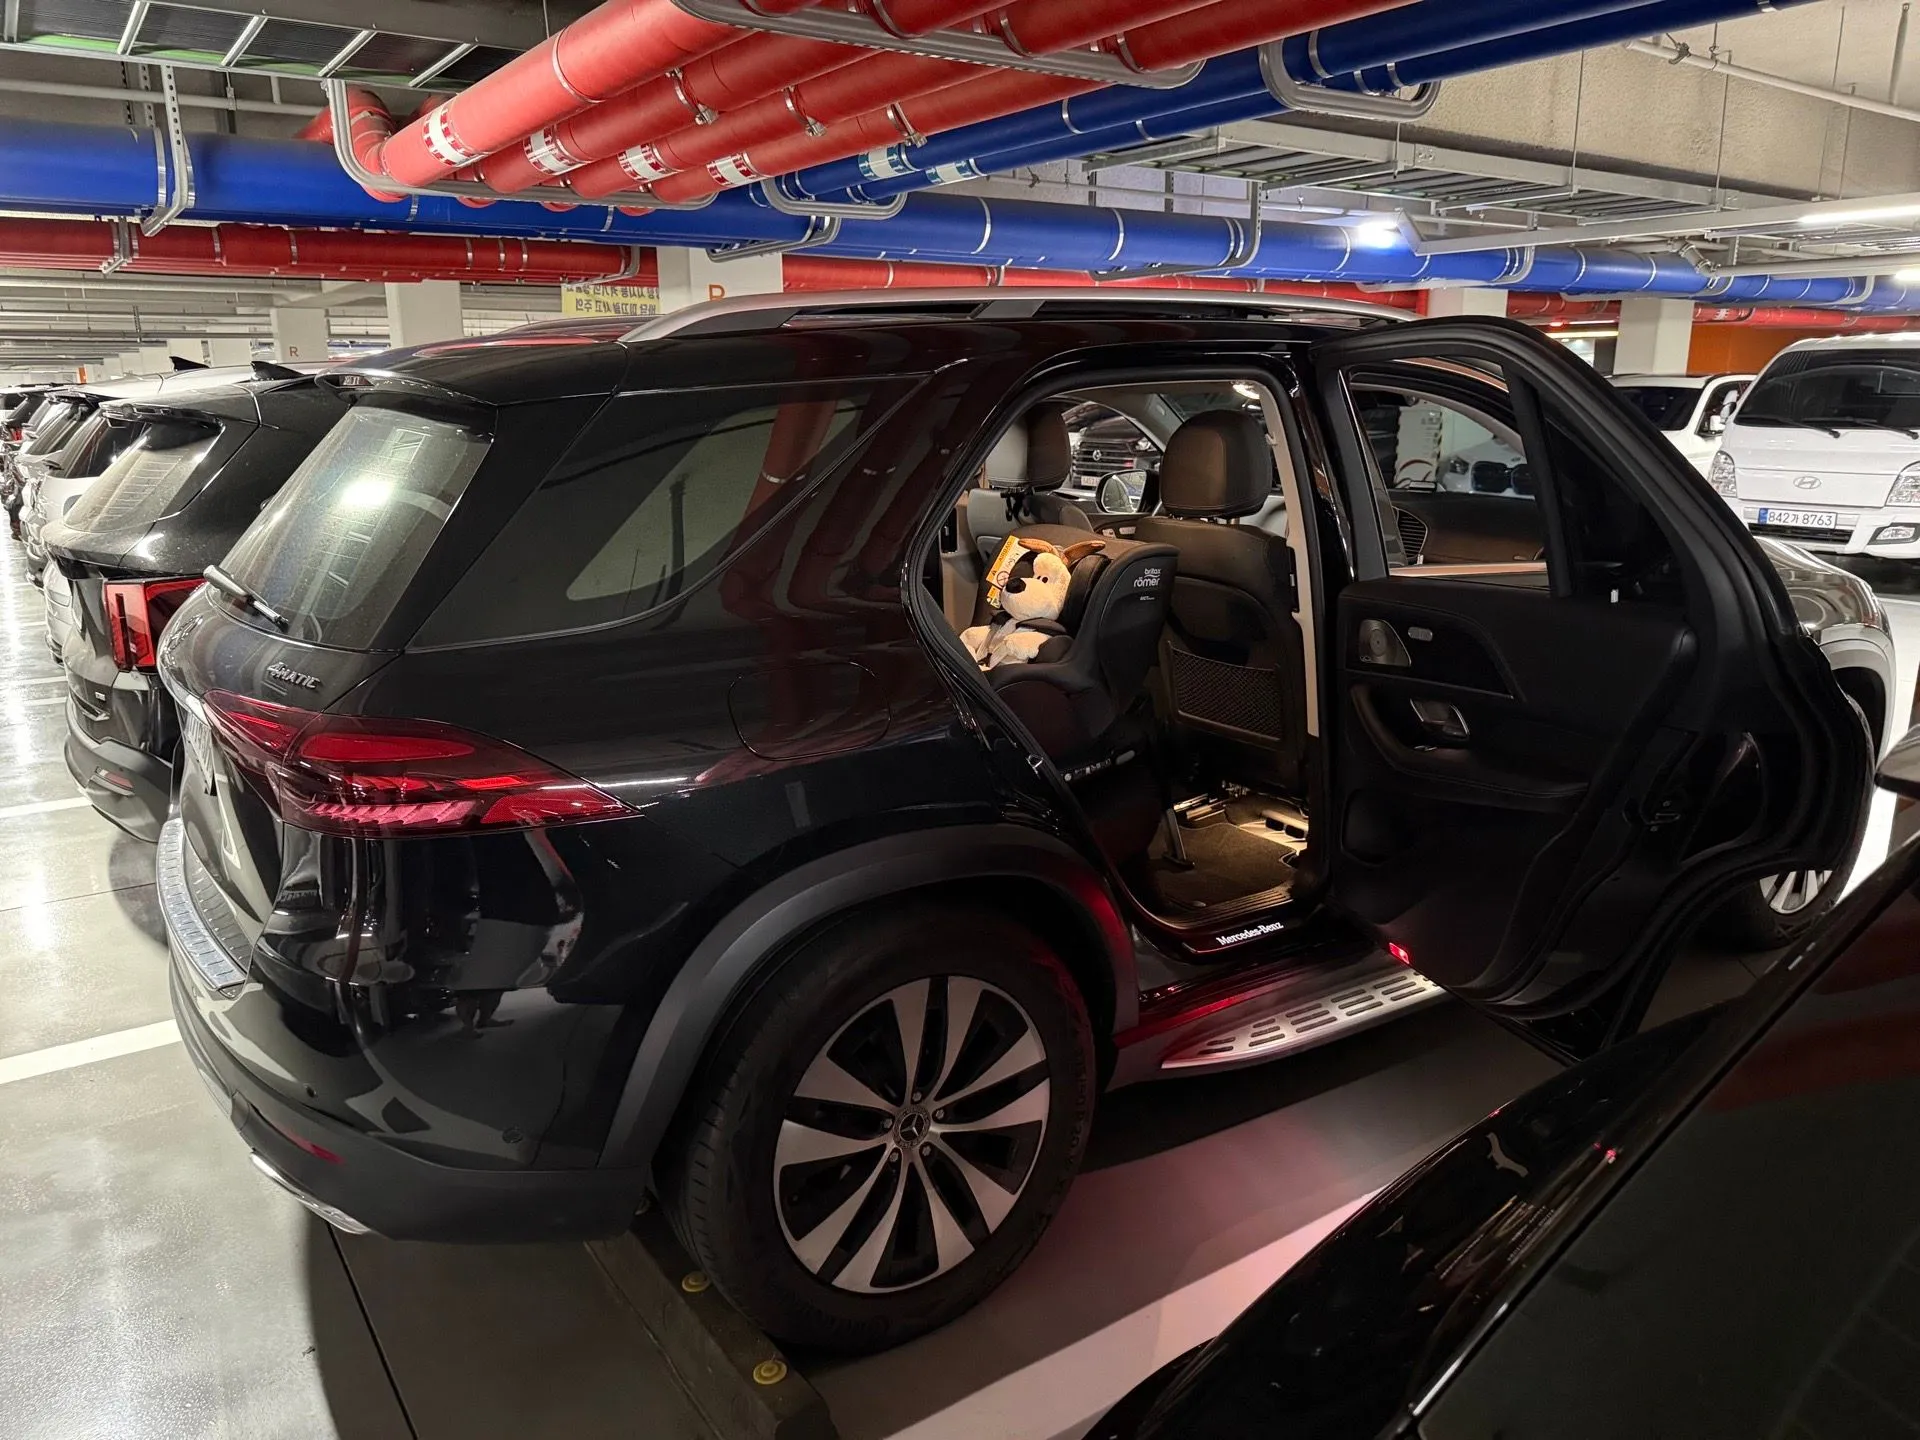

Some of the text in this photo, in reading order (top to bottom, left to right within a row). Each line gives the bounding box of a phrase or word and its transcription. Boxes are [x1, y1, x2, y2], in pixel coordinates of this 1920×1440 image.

[289, 346, 298, 357] R
[1768, 511, 1833, 526] 842가 8763
[1133, 576, 1160, 588] römer
[267, 661, 320, 689] 4MATIC
[1216, 922, 1284, 946] Mercedes-Benz
